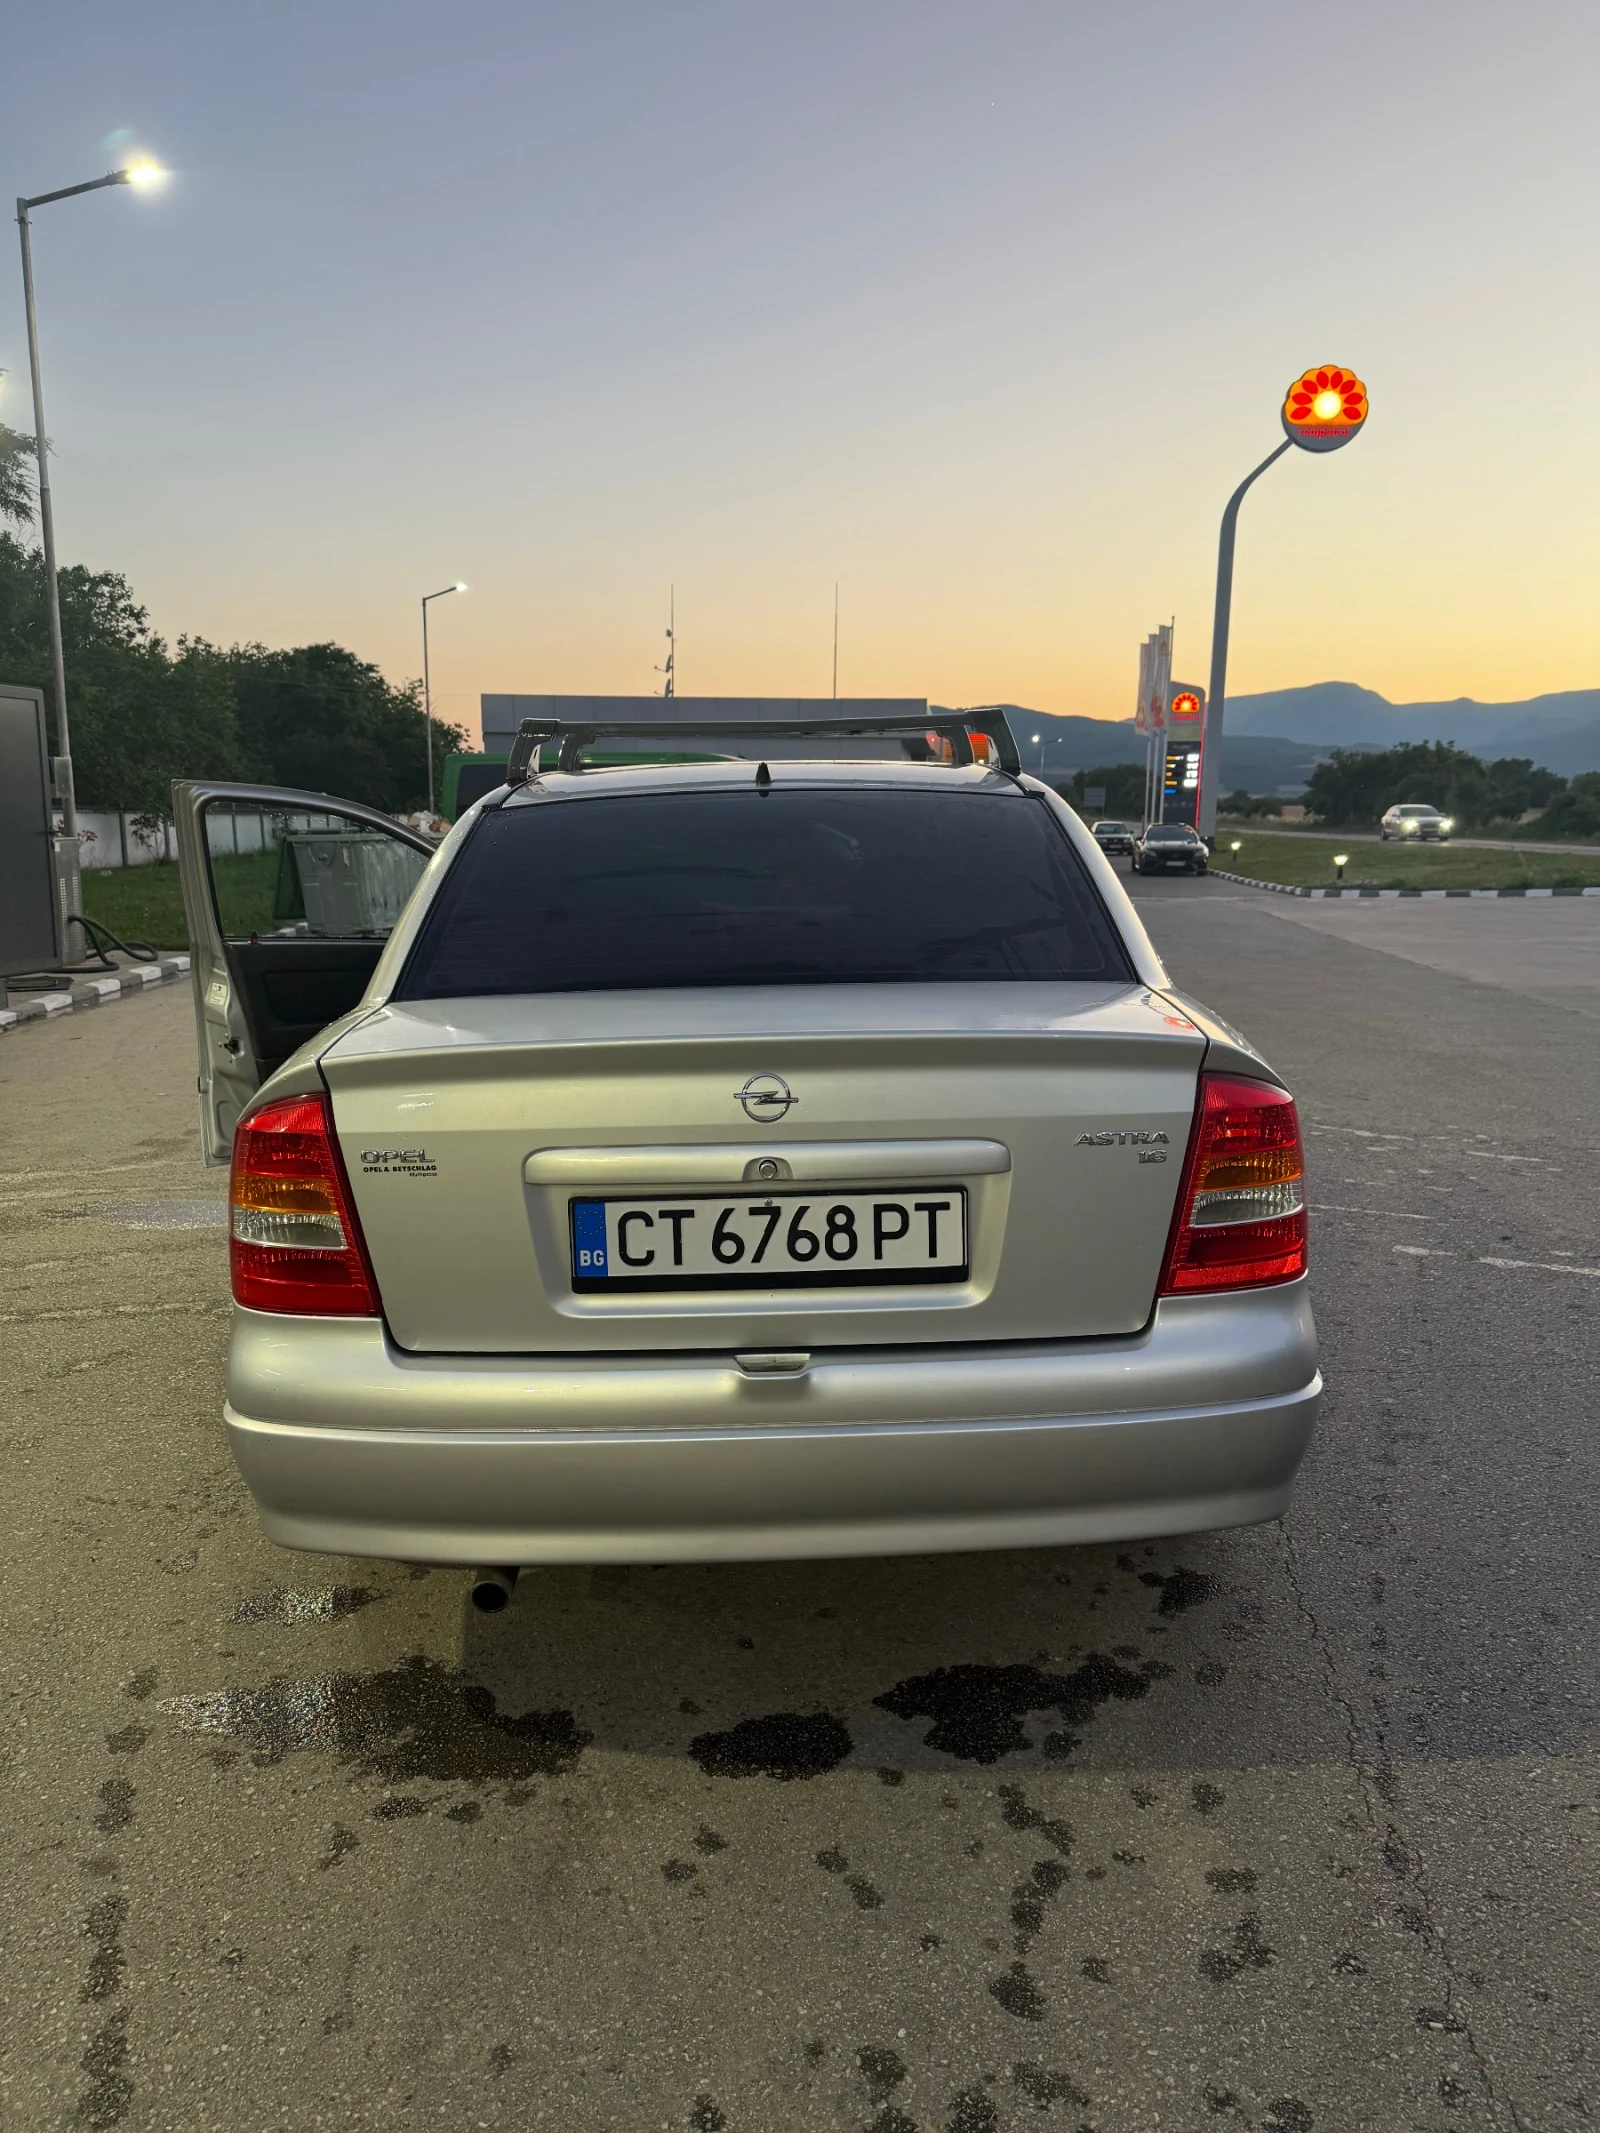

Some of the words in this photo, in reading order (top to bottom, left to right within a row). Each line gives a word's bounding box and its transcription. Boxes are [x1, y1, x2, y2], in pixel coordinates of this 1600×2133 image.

[1298, 427, 1350, 439] rompetrol
[1073, 1130, 1170, 1146] ASTRA
[361, 1149, 436, 1164] OPEL
[617, 1209, 695, 1267] CT
[711, 1204, 858, 1264] 6768
[873, 1202, 951, 1260] PT
[579, 1250, 605, 1267] BG
